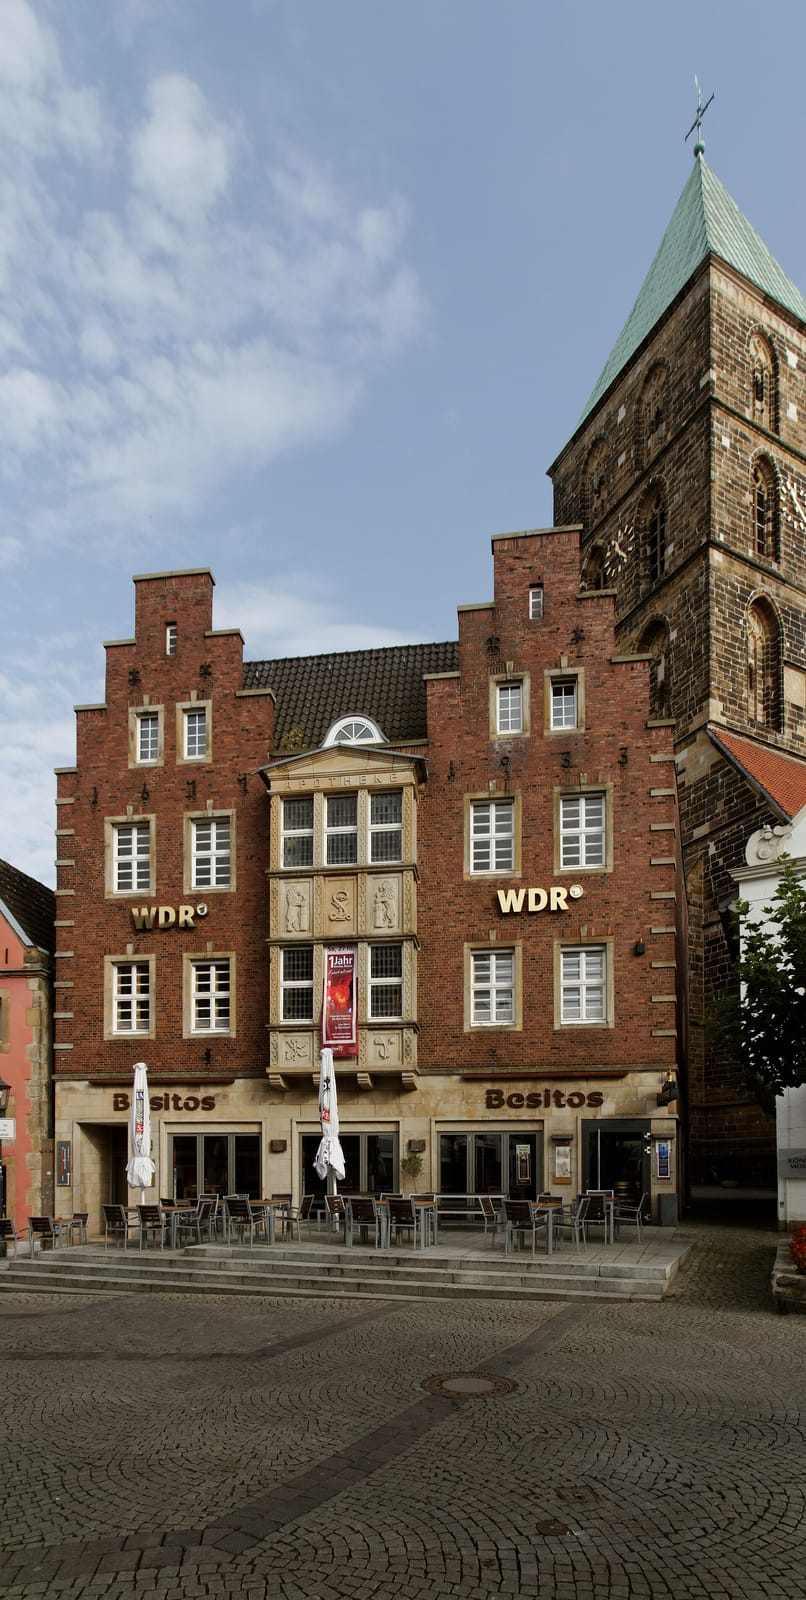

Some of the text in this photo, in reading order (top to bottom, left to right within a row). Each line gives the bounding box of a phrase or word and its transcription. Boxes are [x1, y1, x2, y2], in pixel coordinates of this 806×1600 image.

[284, 774, 398, 790] APOTHEKE
[496, 886, 570, 913] WDR
[131, 905, 196, 930] WDR
[328, 955, 352, 968] 1 Jahr
[113, 1092, 217, 1112] Bsitos
[485, 1088, 604, 1109] Besitos
